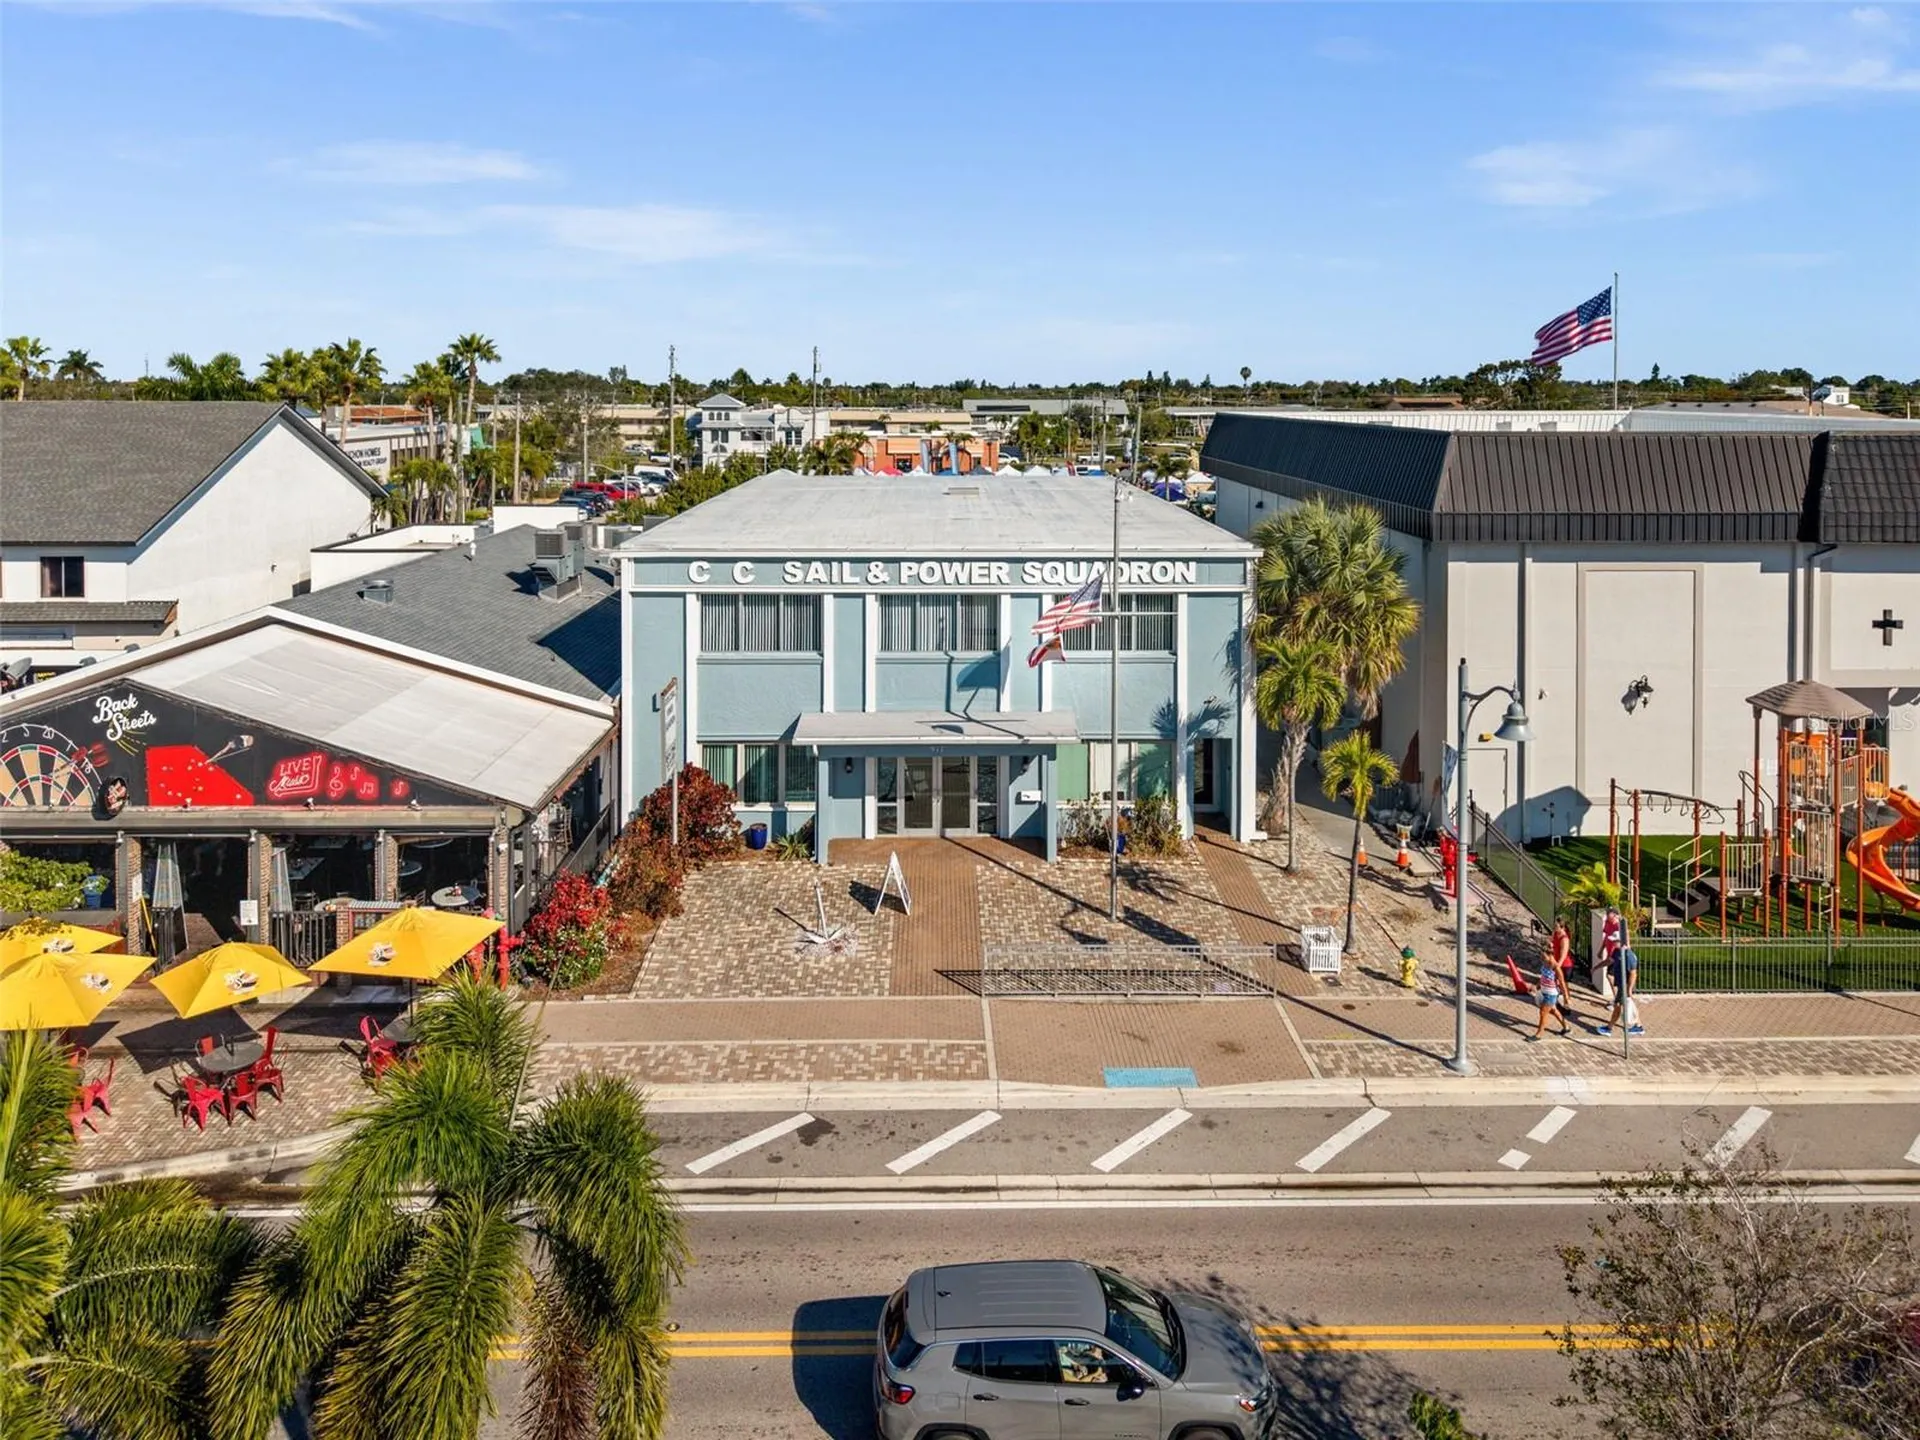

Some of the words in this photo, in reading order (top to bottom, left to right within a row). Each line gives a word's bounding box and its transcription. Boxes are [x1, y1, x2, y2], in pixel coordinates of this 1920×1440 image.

[688, 561, 710, 584] C
[732, 561, 755, 584] C
[783, 561, 860, 584] SAIL
[866, 561, 890, 584] &
[900, 562, 1010, 584] POWER
[1021, 561, 1196, 586] SQUADRON
[92, 693, 139, 724] Back
[106, 710, 157, 741] Streets
[280, 757, 312, 776] LIVE
